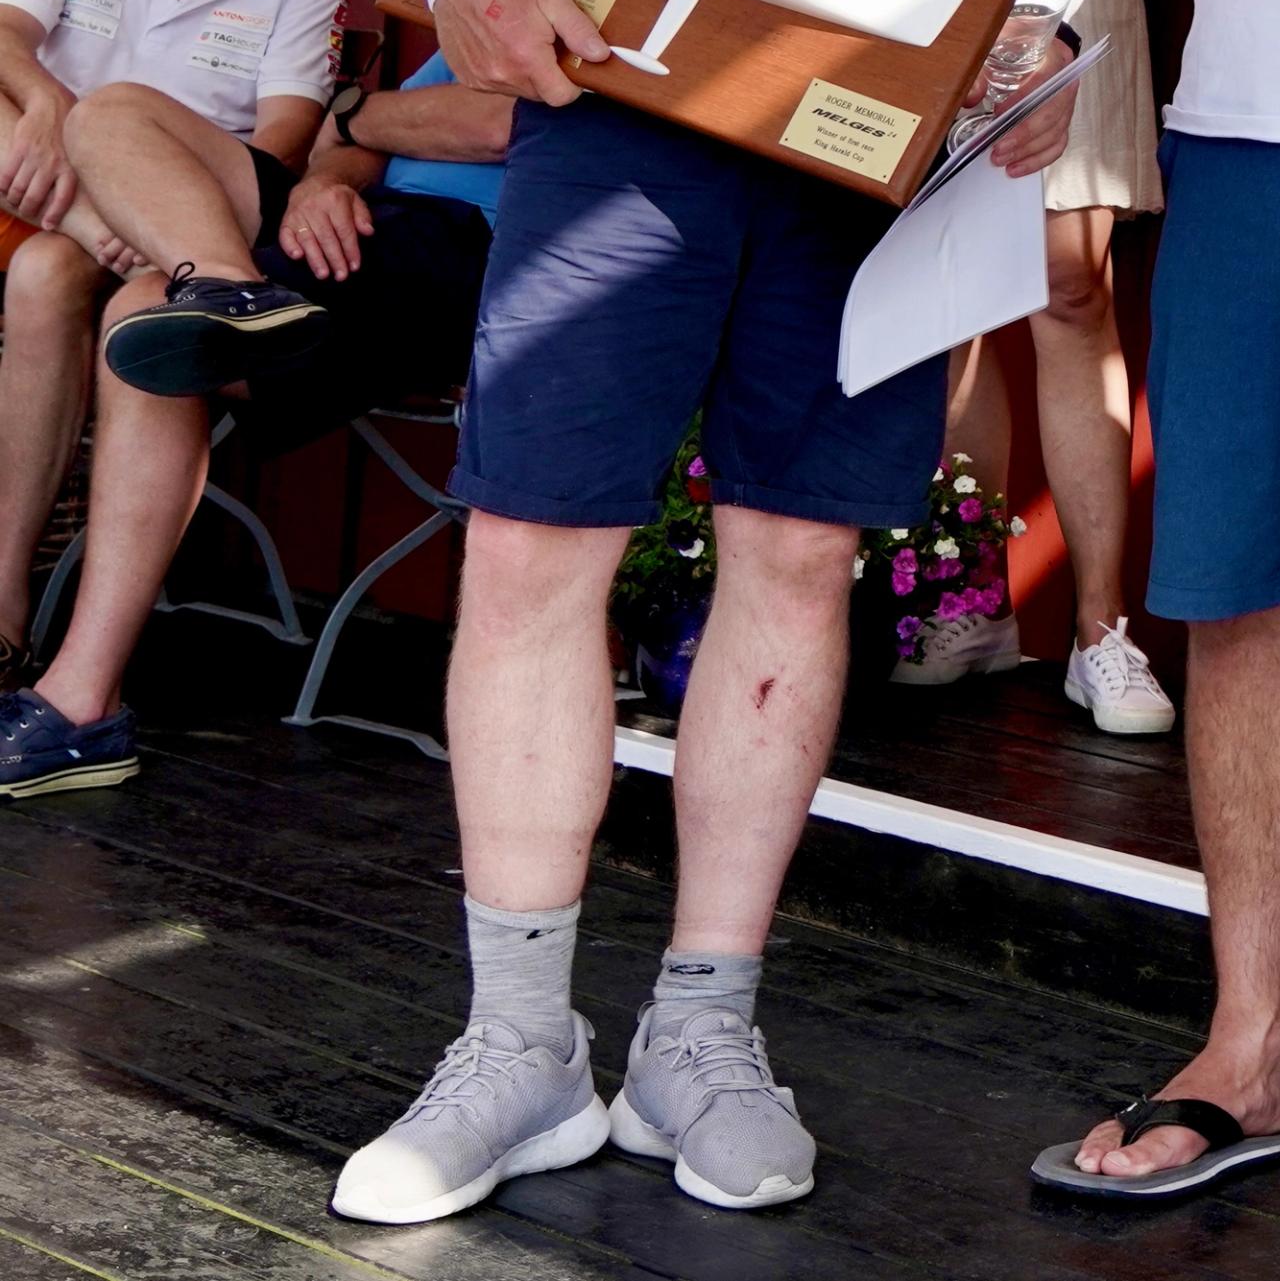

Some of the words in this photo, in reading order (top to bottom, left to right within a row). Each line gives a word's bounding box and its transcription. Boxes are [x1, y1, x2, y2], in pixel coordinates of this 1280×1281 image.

[812, 107, 886, 138] MELGES
[825, 94, 853, 110] ROGER
[855, 105, 895, 127] MEMORIAL
[816, 126, 838, 139] Winner
[814, 139, 829, 151] King
[830, 143, 851, 158] Harald
[852, 152, 865, 163] Cup
